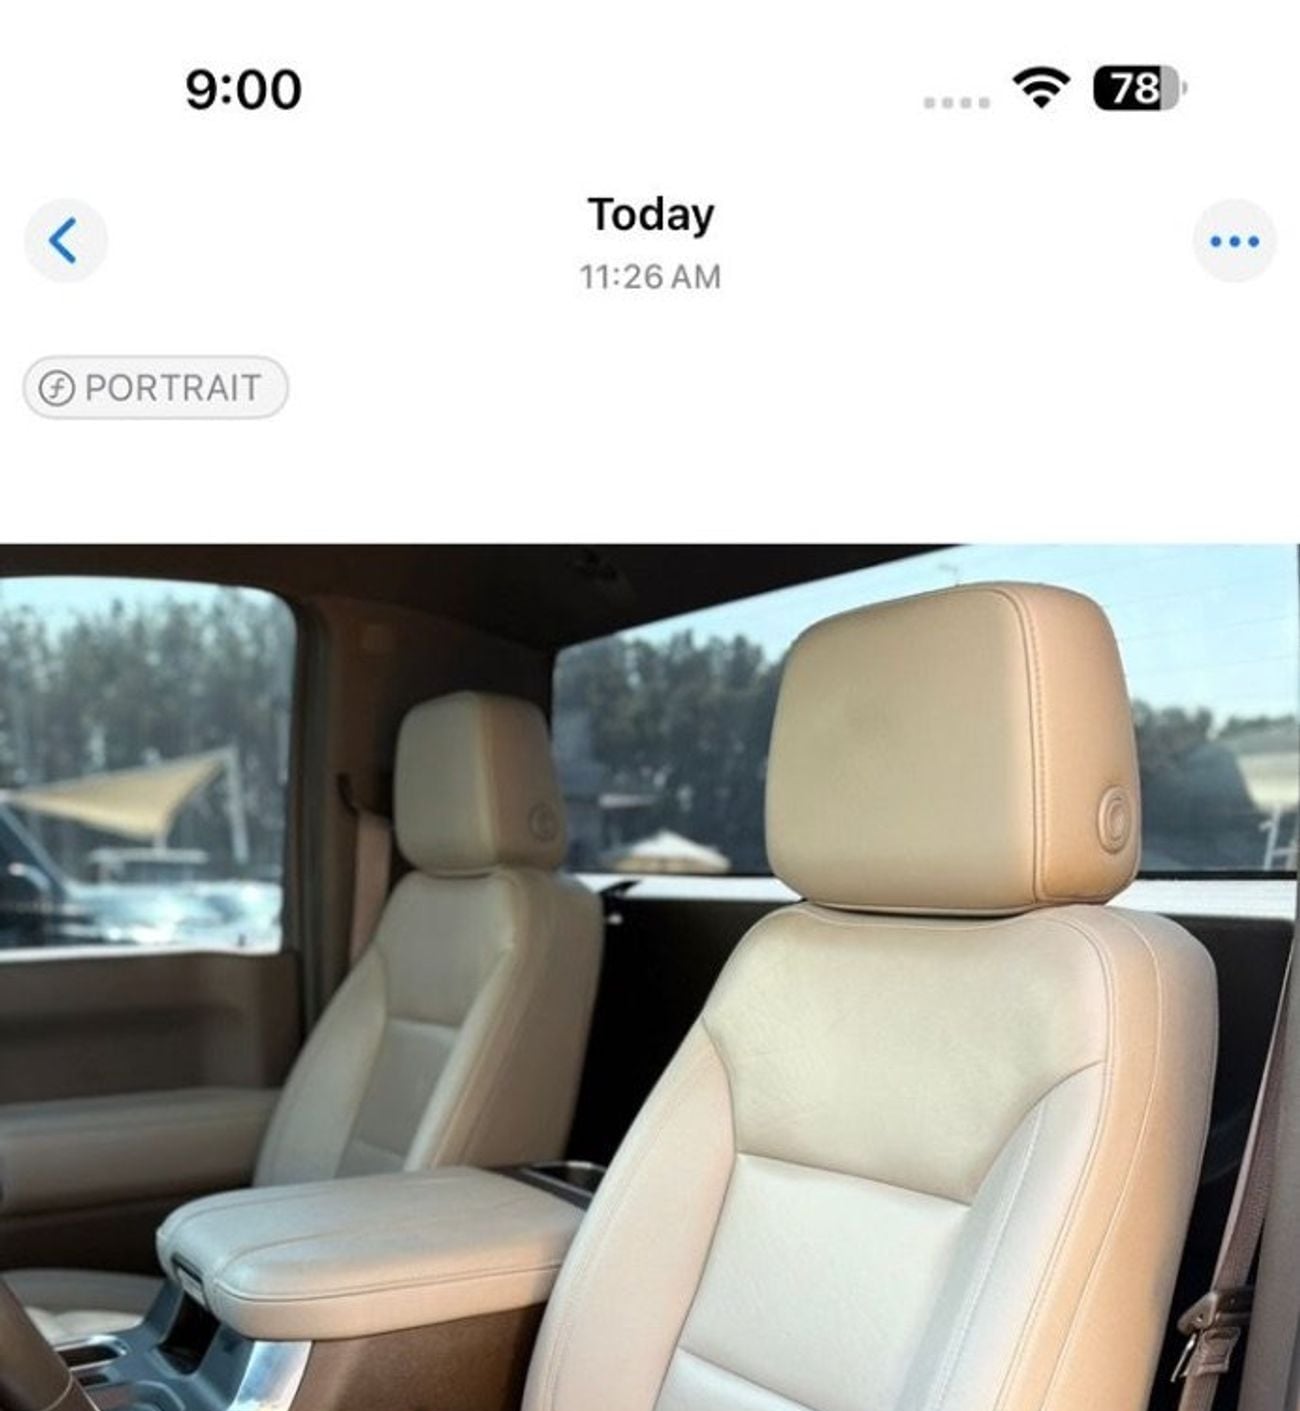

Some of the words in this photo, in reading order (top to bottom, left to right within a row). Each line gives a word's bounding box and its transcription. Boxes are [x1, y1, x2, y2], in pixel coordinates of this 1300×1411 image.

[185, 68, 302, 111] 9:00
[1111, 72, 1159, 104] 78
[586, 195, 716, 240] Today
[580, 263, 664, 290] 11:26
[670, 263, 721, 290] AM
[86, 373, 262, 402] PORTRAIT
